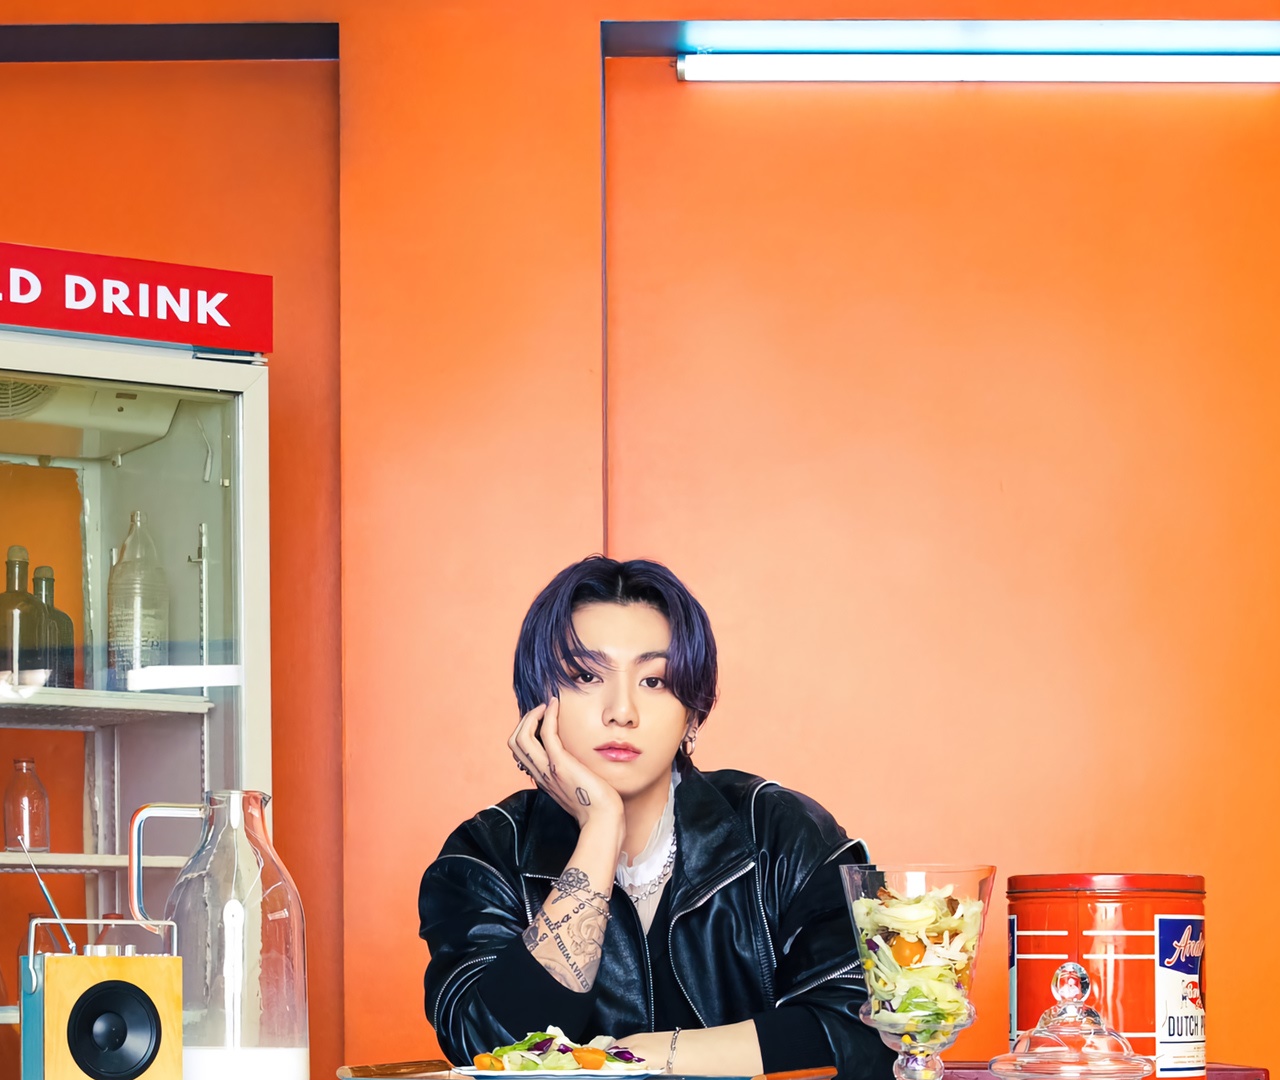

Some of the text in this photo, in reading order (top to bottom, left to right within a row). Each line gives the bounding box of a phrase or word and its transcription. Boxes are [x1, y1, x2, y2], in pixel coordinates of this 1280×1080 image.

[65, 275, 231, 327] DRINK
[543, 915, 557, 934] THE
[569, 961, 583, 980] HAY
[1168, 1015, 1199, 1037] DUTCH
